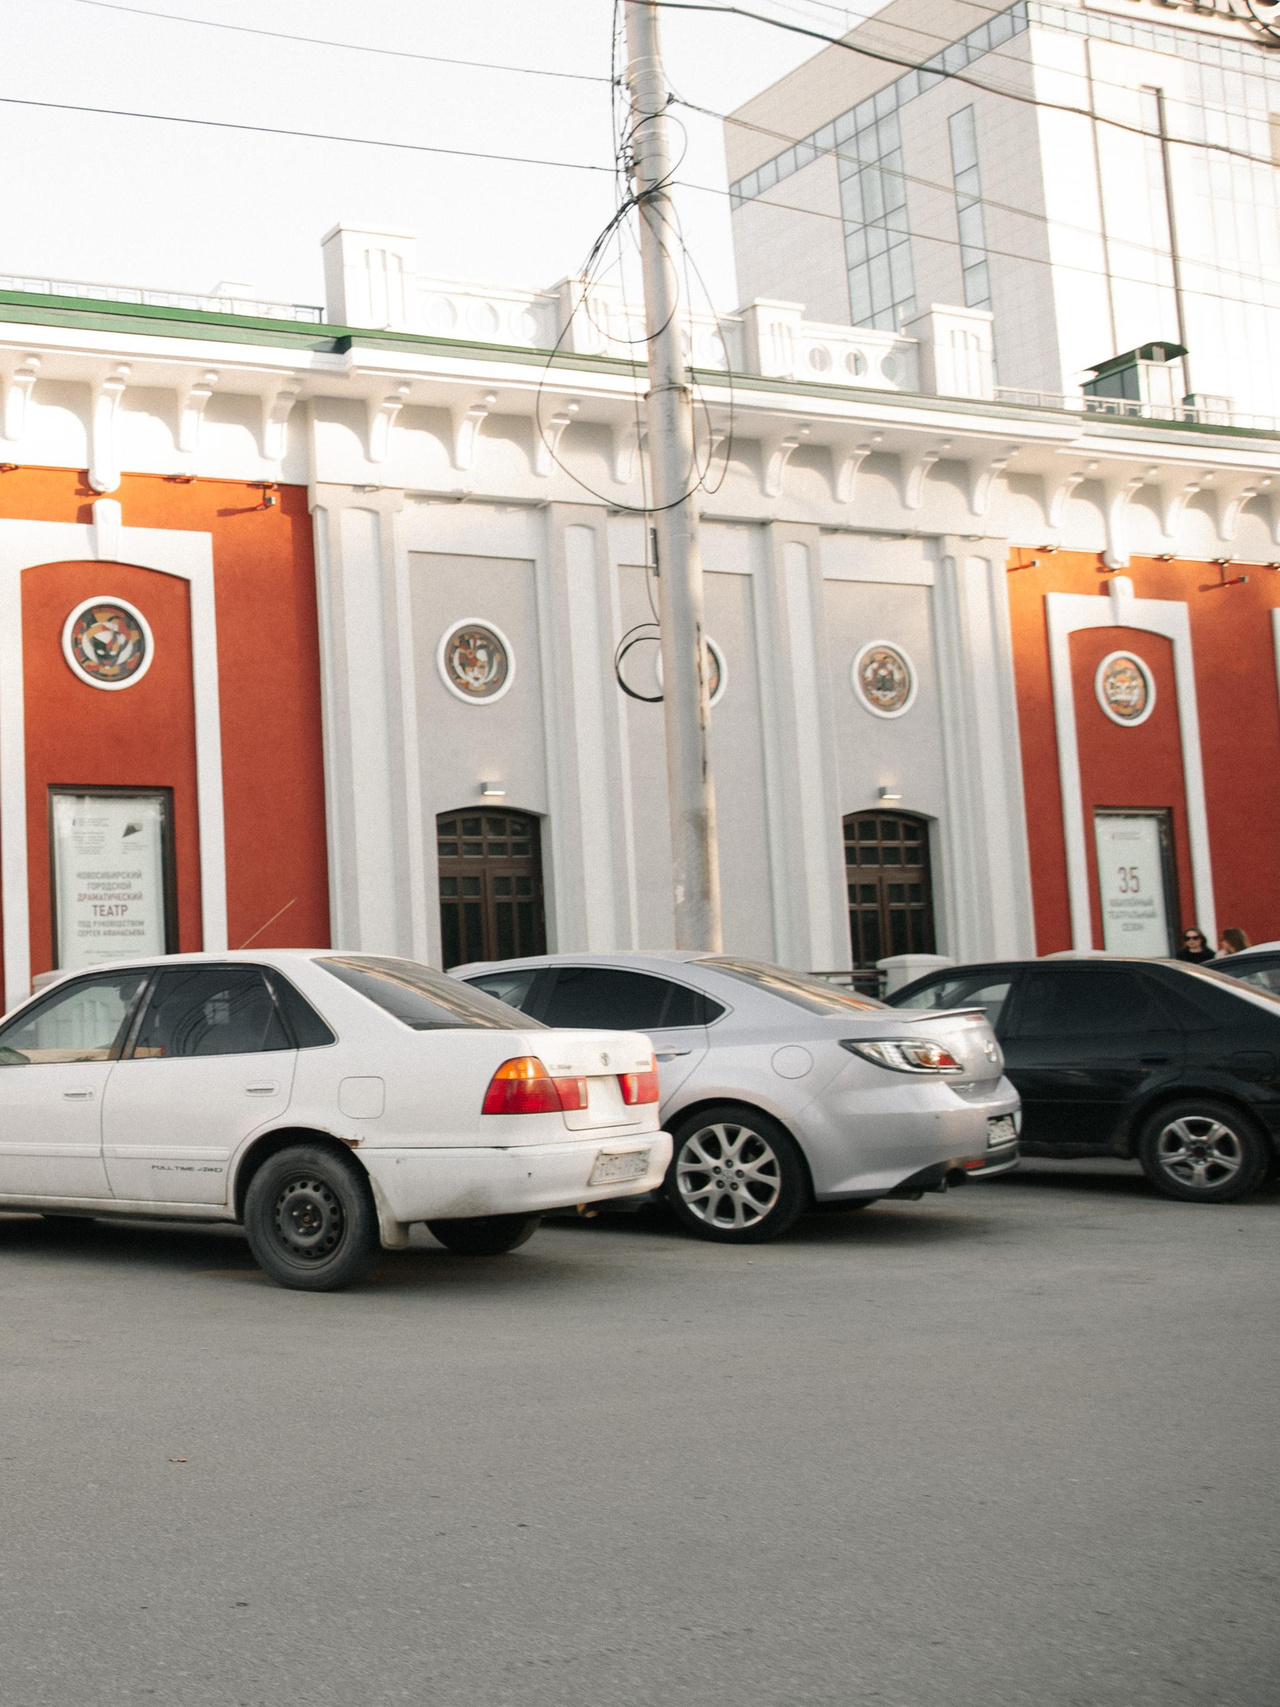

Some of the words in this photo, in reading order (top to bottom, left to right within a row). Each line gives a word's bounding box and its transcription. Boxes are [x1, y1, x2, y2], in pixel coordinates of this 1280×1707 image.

[76, 869, 142, 880] НОВОСИБИРСКИЙ
[1118, 866, 1140, 894] 35
[87, 880, 132, 891] ГОРОДСКОЙ
[77, 891, 143, 902] ДРАМАТИЧЕСКИЙ
[92, 904, 128, 917] ТЕАТР
[93, 920, 144, 928] РУКОВОДСТВОМ
